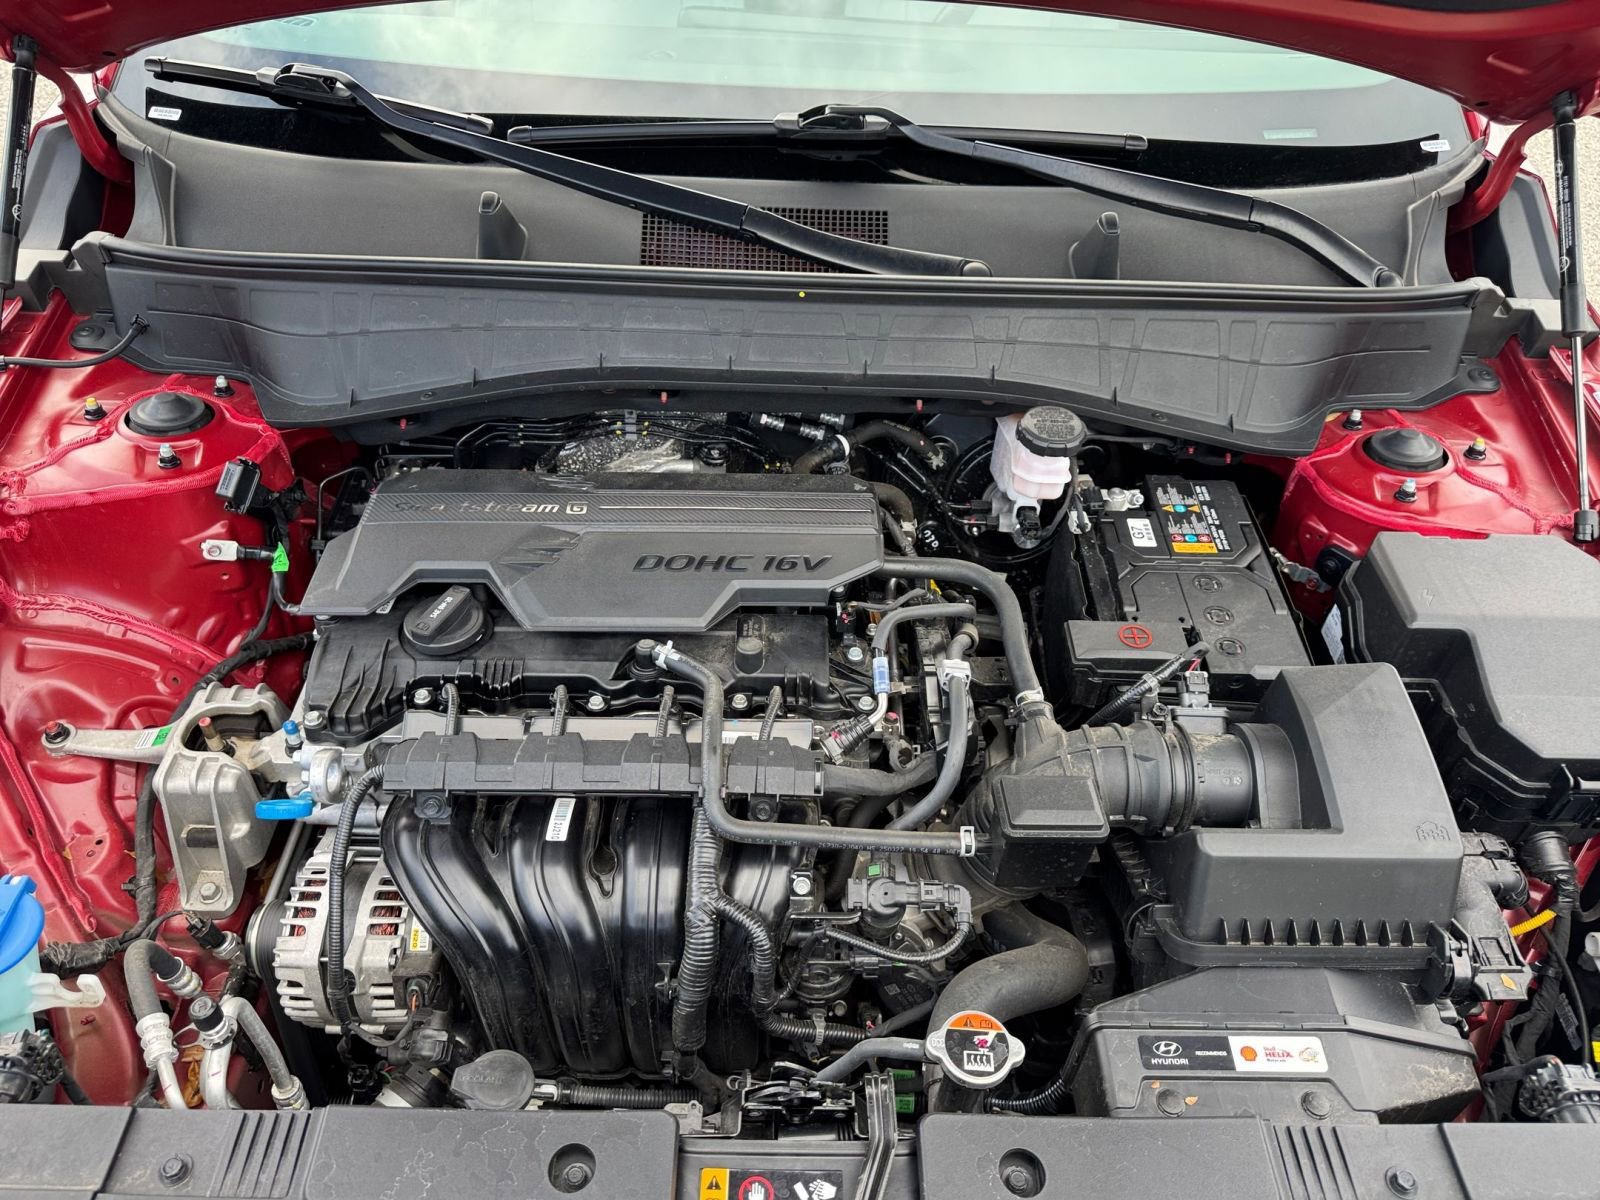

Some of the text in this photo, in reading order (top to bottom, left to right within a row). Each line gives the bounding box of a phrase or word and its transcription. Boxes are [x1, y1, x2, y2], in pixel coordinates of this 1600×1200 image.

[393, 500, 587, 514] Smatstream G
[1131, 526, 1145, 540] G7
[632, 554, 832, 574] DOHC 16V
[429, 608, 441, 619] SAE
[1151, 1057, 1189, 1066] HYUNDAI
